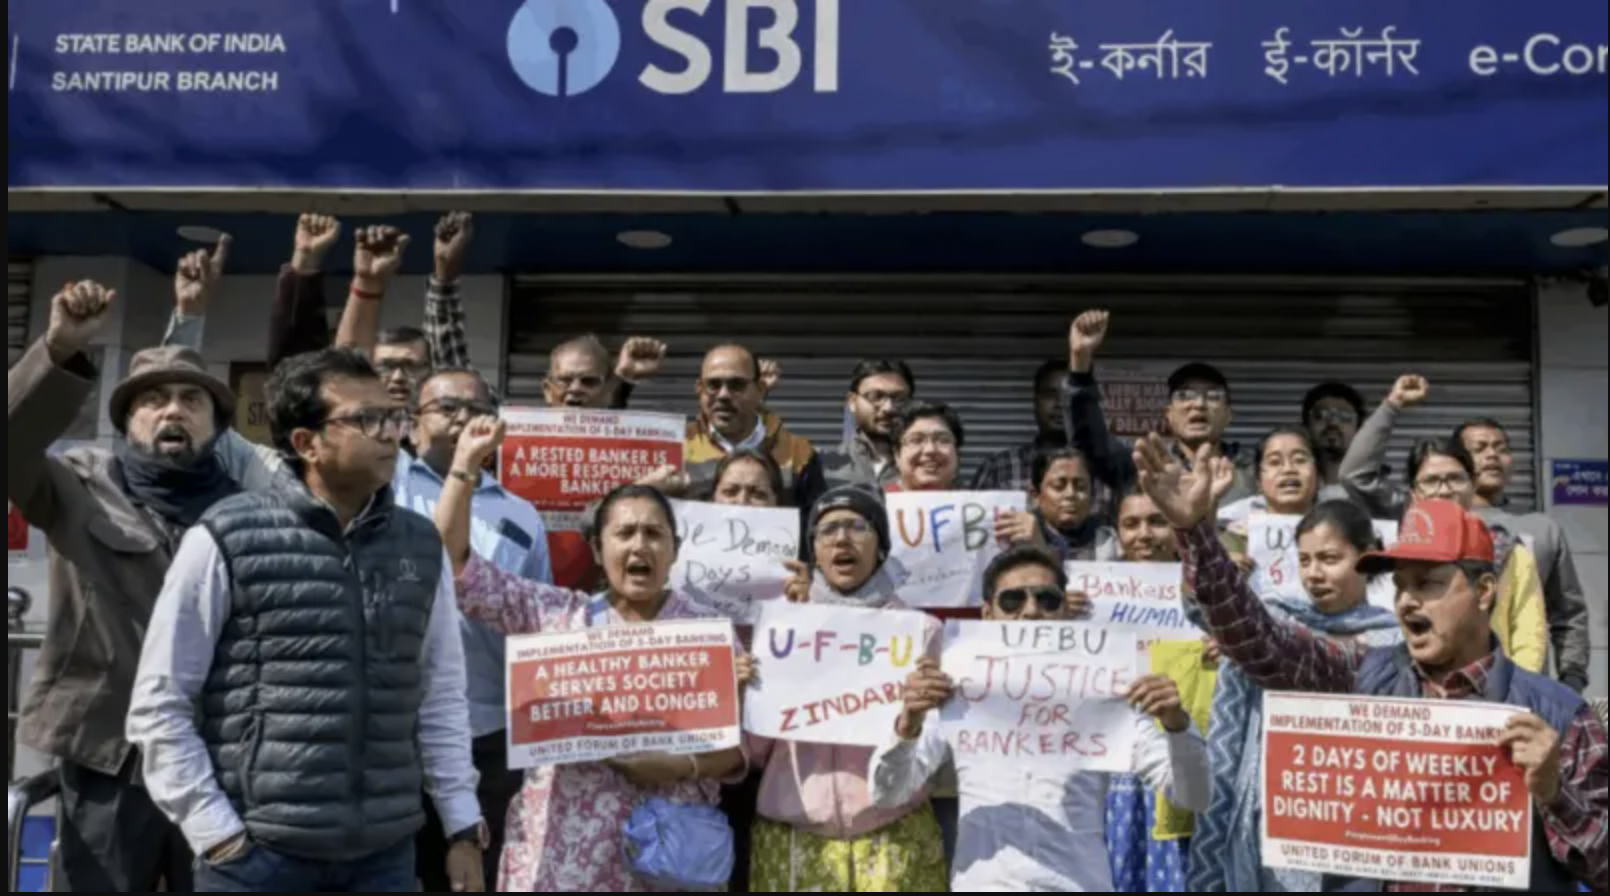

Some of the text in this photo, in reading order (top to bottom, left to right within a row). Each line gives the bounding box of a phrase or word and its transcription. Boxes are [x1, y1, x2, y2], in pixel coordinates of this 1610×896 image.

[55, 34, 286, 53] STATE BANK OF INDIA
[640, 0, 839, 94] SBI
[1049, 29, 1212, 85] ই-কর্নার
[1261, 26, 1420, 84] ई-कॉर्नर
[52, 72, 278, 91] SANTIPUR BRANCH
[580, 414, 620, 425] DEMAND
[514, 447, 667, 465] A RESTED BANKER IS
[509, 463, 655, 481] A MORE RESPONSI
[517, 633, 727, 658] IMPLEMENTATION OF 5-DAY BANKING
[587, 626, 655, 641] WE DEMAND
[1002, 625, 1107, 655] UFBU
[769, 627, 913, 668] U-F-B-U
[535, 651, 710, 680] A HEALTHY BANKER
[958, 656, 1129, 702] JUSTICE
[549, 671, 698, 698] SERVES SOCIETY
[530, 690, 719, 722] BETTER AND LONGER
[1018, 703, 1072, 727] FOR
[1350, 704, 1431, 721] WE DEMAND
[1270, 715, 1382, 734] IMPLEMENTATION
[1386, 721, 1405, 735] OF
[1409, 722, 1451, 738] 5-DAY
[529, 740, 573, 757] UNITED
[577, 738, 619, 751] FORUM
[622, 736, 637, 748] OF
[643, 735, 674, 747] BANK
[678, 731, 725, 745] UNIONS
[958, 730, 1108, 757] BANKERS
[1293, 744, 1497, 777] 2 DAYS OF WEEKLY
[1282, 771, 1511, 803] REST IS A MATTER OF
[1273, 796, 1354, 822] DIGNITY
[1376, 806, 1423, 828] NOT
[1430, 809, 1523, 832] LUXURY
[1280, 844, 1328, 860] UNITED
[1333, 850, 1381, 865] FORUM
[1386, 855, 1405, 867] OF
[1412, 857, 1451, 870] BANK
[1458, 859, 1515, 875] UNIONS
